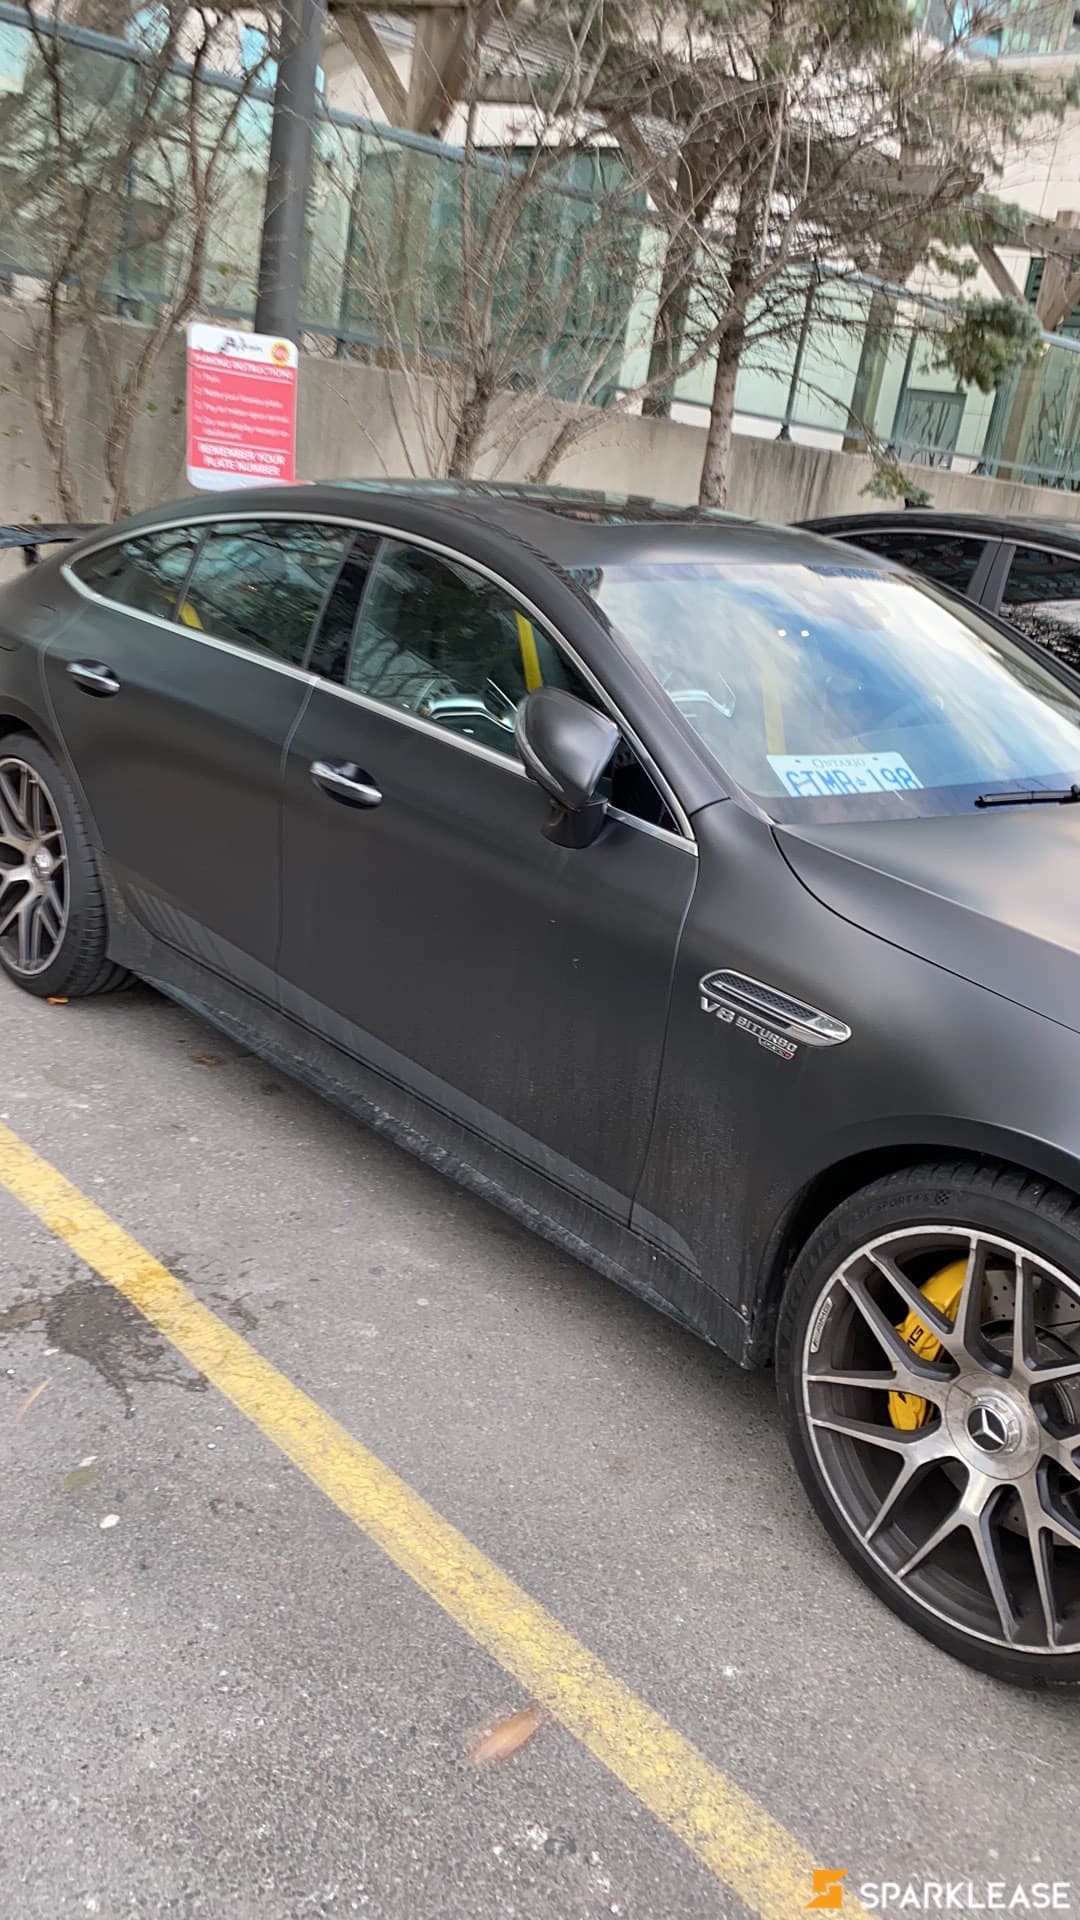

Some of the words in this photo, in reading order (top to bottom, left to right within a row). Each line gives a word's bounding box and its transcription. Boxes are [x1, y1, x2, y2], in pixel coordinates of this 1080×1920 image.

[198, 443, 256, 461] REMEMBER
[257, 452, 286, 466] YOUR
[203, 456, 237, 471] PLATE
[238, 461, 280, 477] NUMBER
[811, 757, 866, 769] ONTARIO
[700, 996, 736, 1024] V8
[735, 1016, 798, 1053] BITURBO
